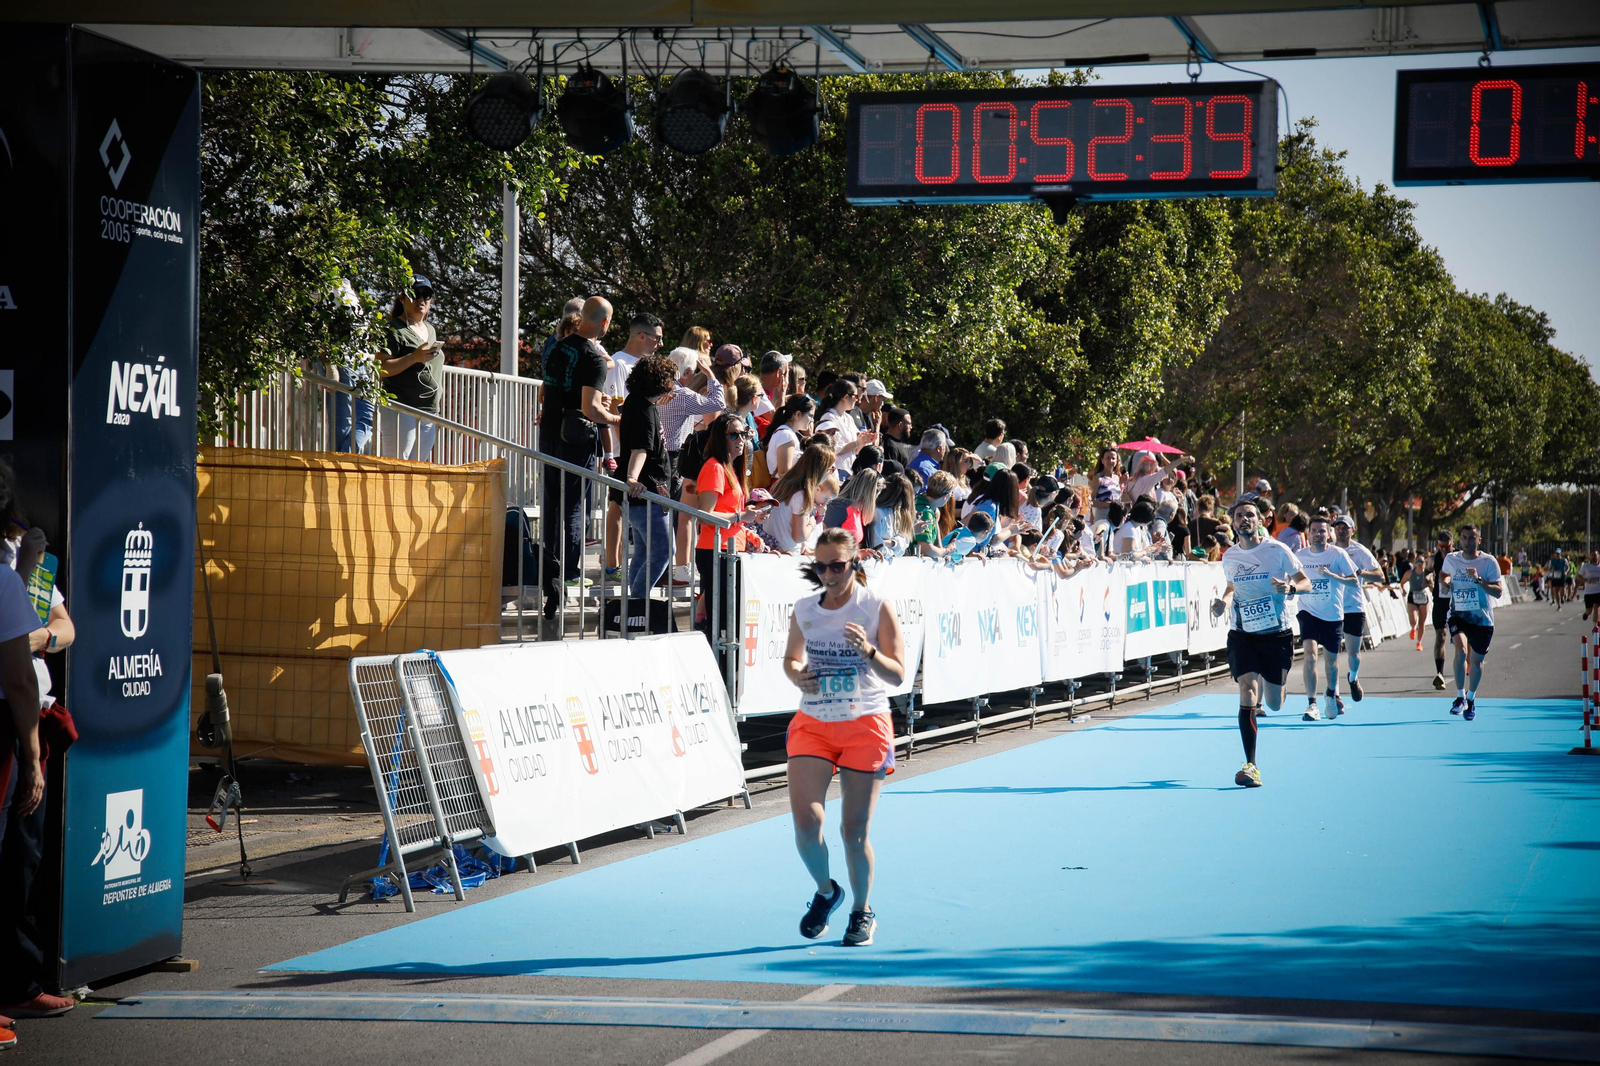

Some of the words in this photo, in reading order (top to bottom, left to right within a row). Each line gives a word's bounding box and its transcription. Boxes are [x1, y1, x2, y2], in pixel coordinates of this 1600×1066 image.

[1469, 80, 1600, 166] 01:
[100, 195, 181, 232] COOPERACIÓN
[101, 219, 130, 243] 2005
[113, 413, 130, 425] 2020
[1243, 602, 1271, 616] 5665
[108, 648, 162, 680] ALMERÍA
[838, 649, 859, 657] 202
[122, 681, 151, 697] CIUDAD
[813, 676, 855, 695] 166
[499, 694, 566, 748] ALMERÍA
[599, 682, 663, 732] ALMERÍA
[508, 753, 547, 783] CIUDAD
[103, 886, 138, 905] DEPORTES
[138, 884, 148, 897] DE
